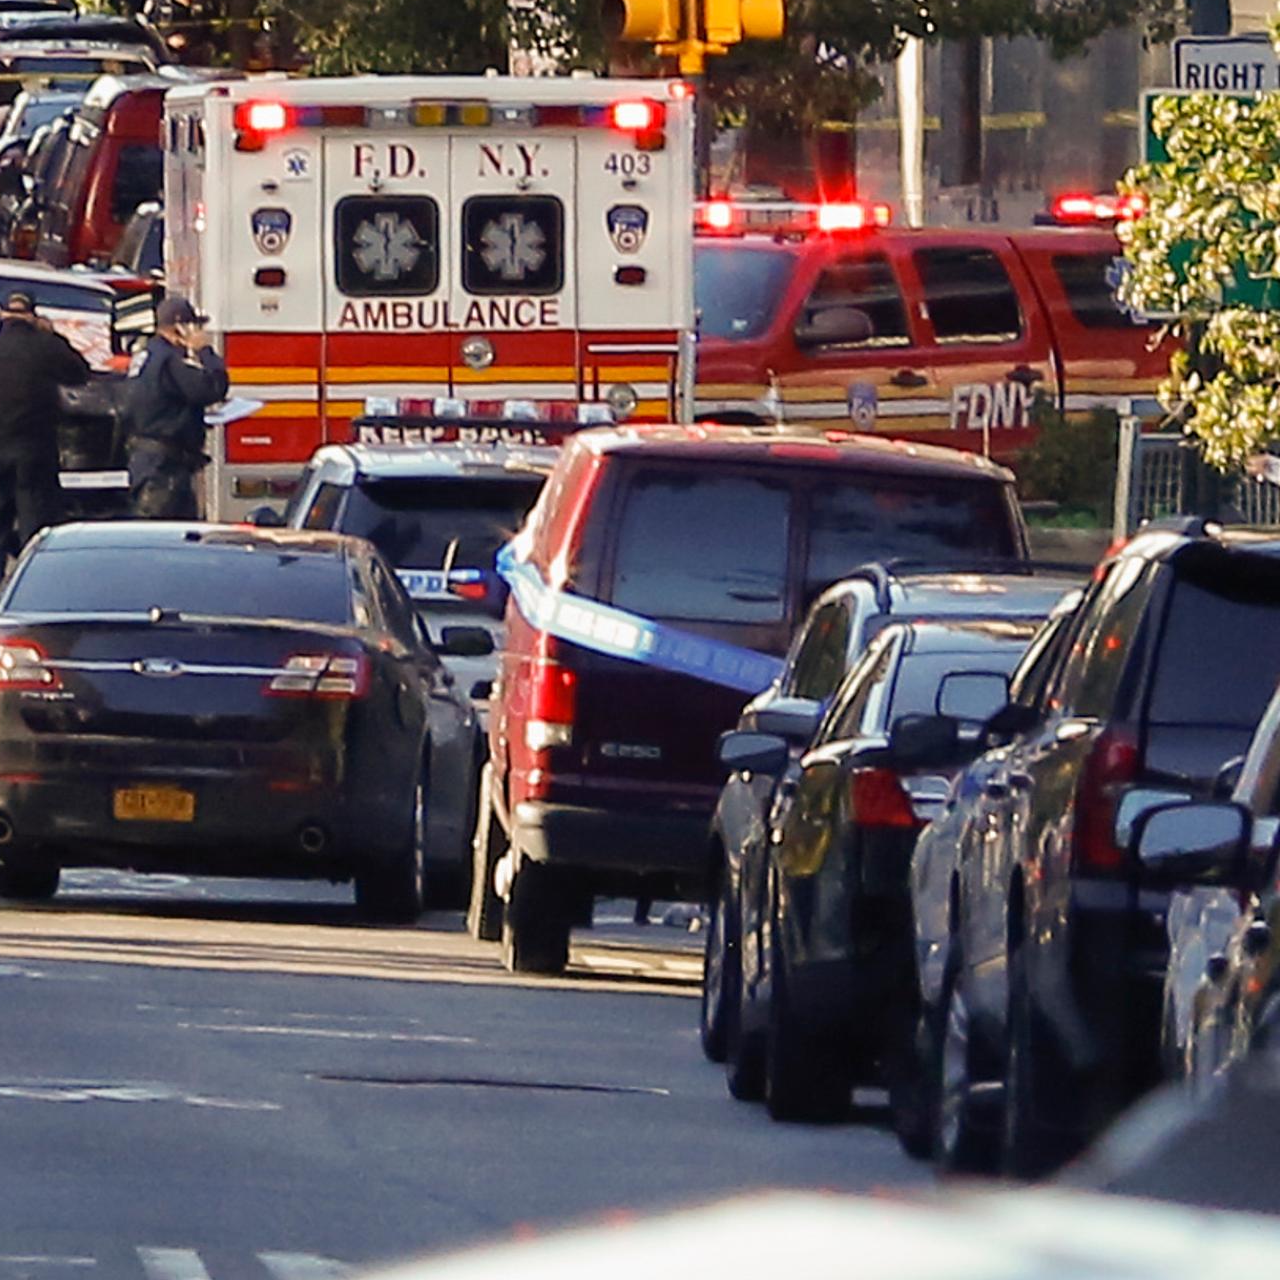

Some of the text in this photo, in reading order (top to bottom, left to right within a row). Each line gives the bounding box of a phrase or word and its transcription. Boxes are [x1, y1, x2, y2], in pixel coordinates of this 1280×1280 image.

[1186, 63, 1266, 89] RIGHT
[353, 142, 550, 178] F.D. N.Y.
[604, 153, 652, 175] 403
[338, 298, 560, 329] AMBULANCE
[949, 382, 1037, 431] FDNY
